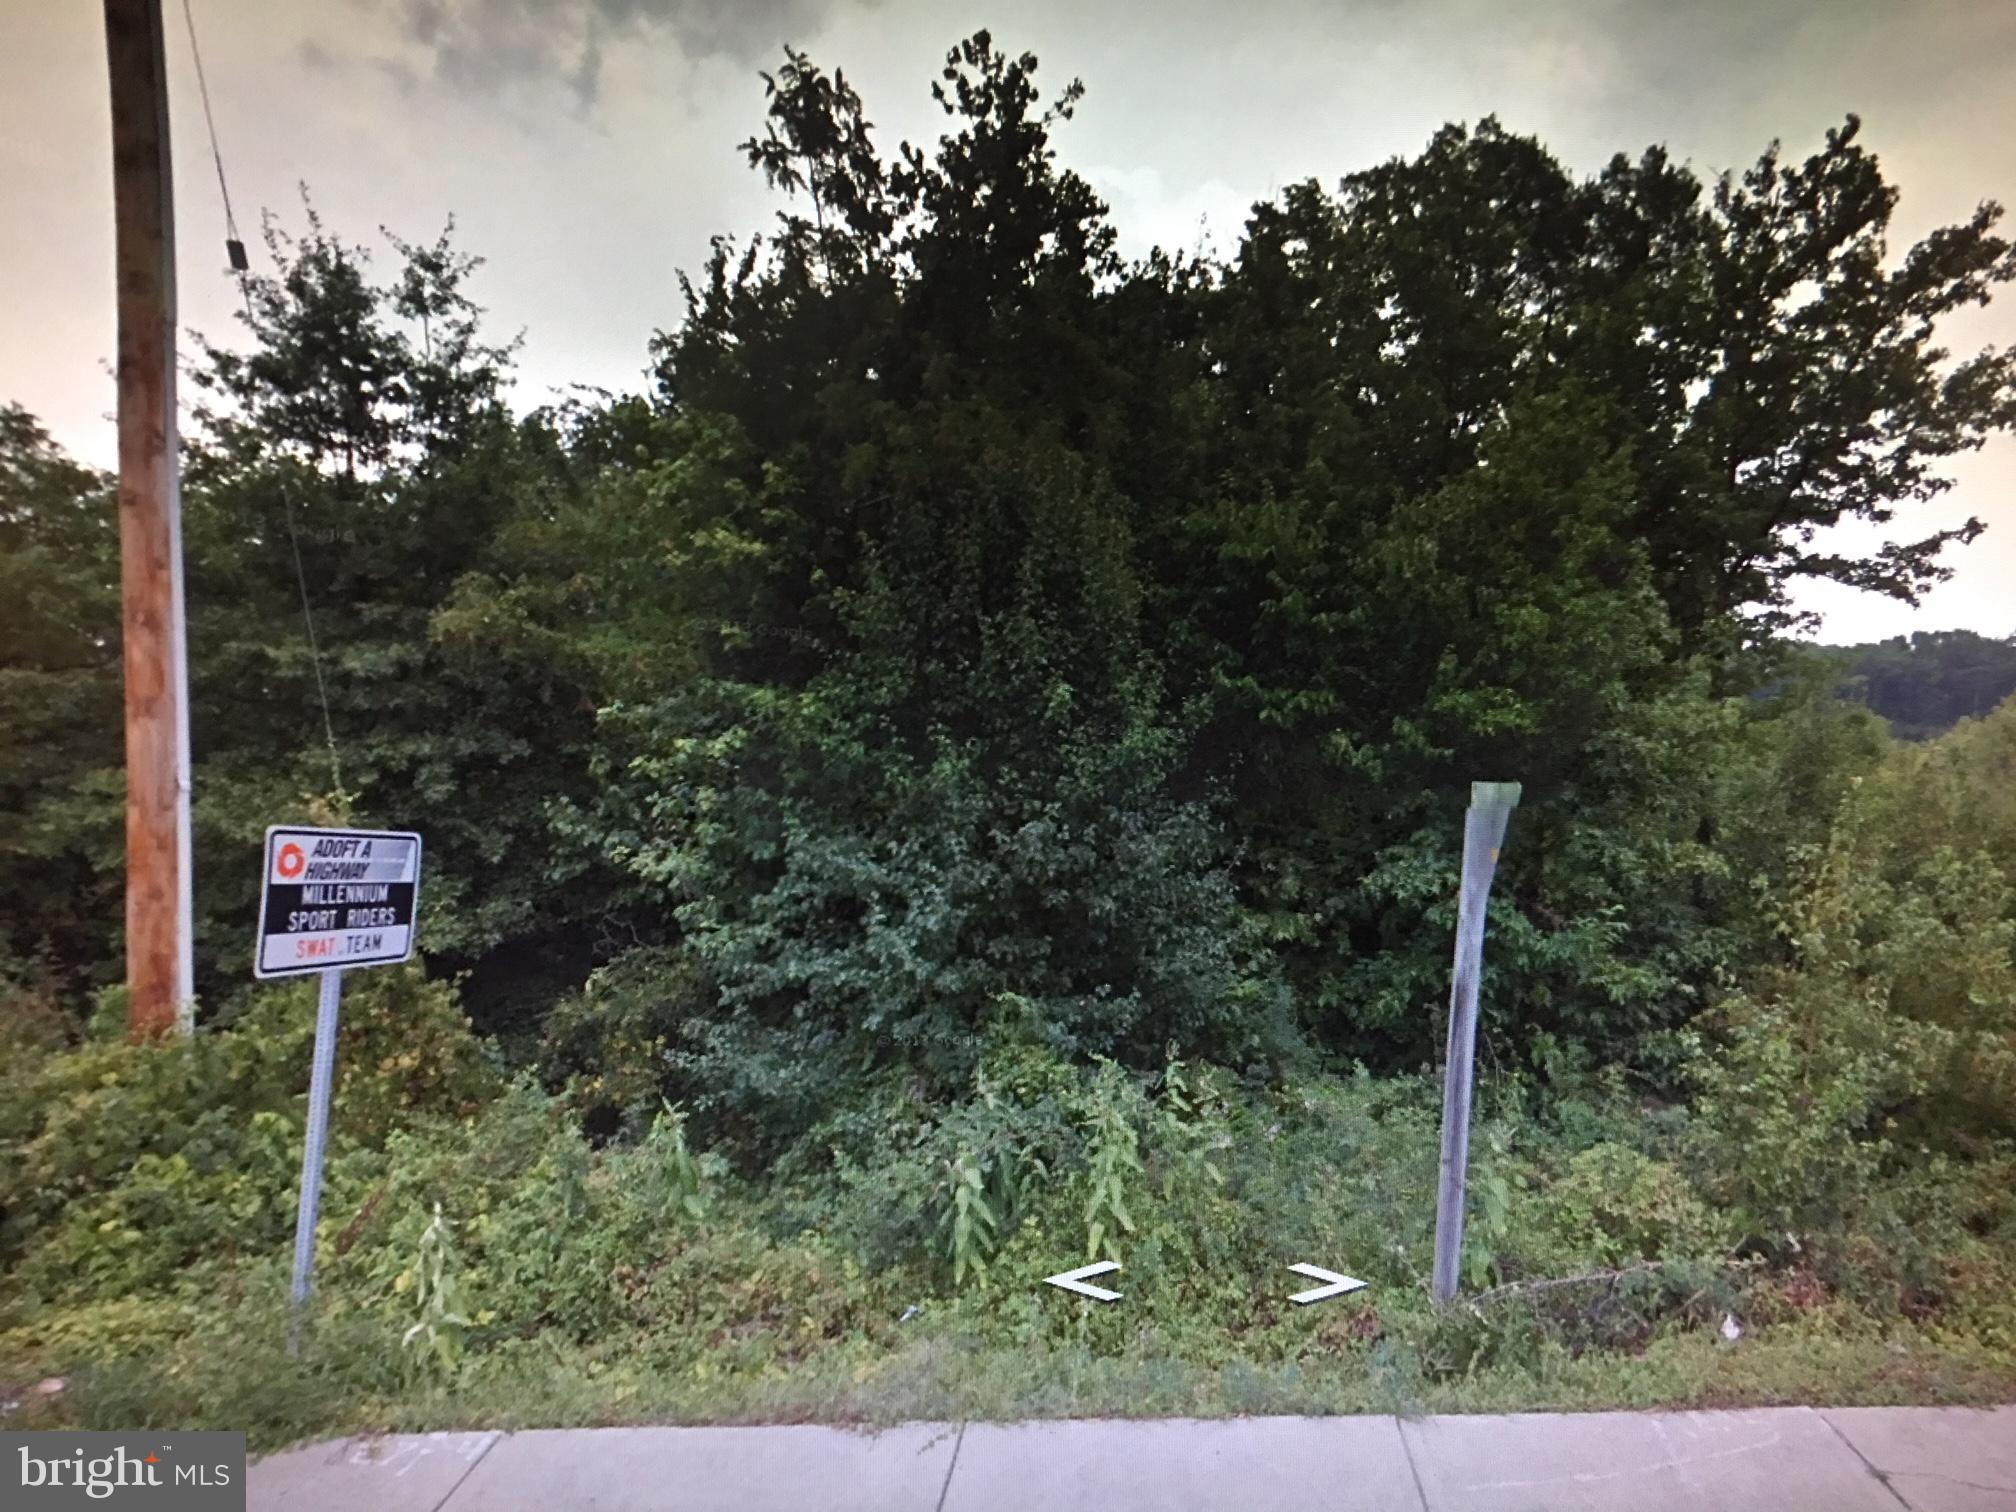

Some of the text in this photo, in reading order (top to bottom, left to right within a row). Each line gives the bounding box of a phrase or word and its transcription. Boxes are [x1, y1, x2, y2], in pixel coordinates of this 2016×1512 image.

[361, 840, 373, 859] A
[304, 861, 371, 881] HIGHWAY
[301, 884, 389, 906] MILLENNIUM
[287, 906, 396, 932] SPORT RIDERS
[295, 934, 384, 960] SWAT TEAM
